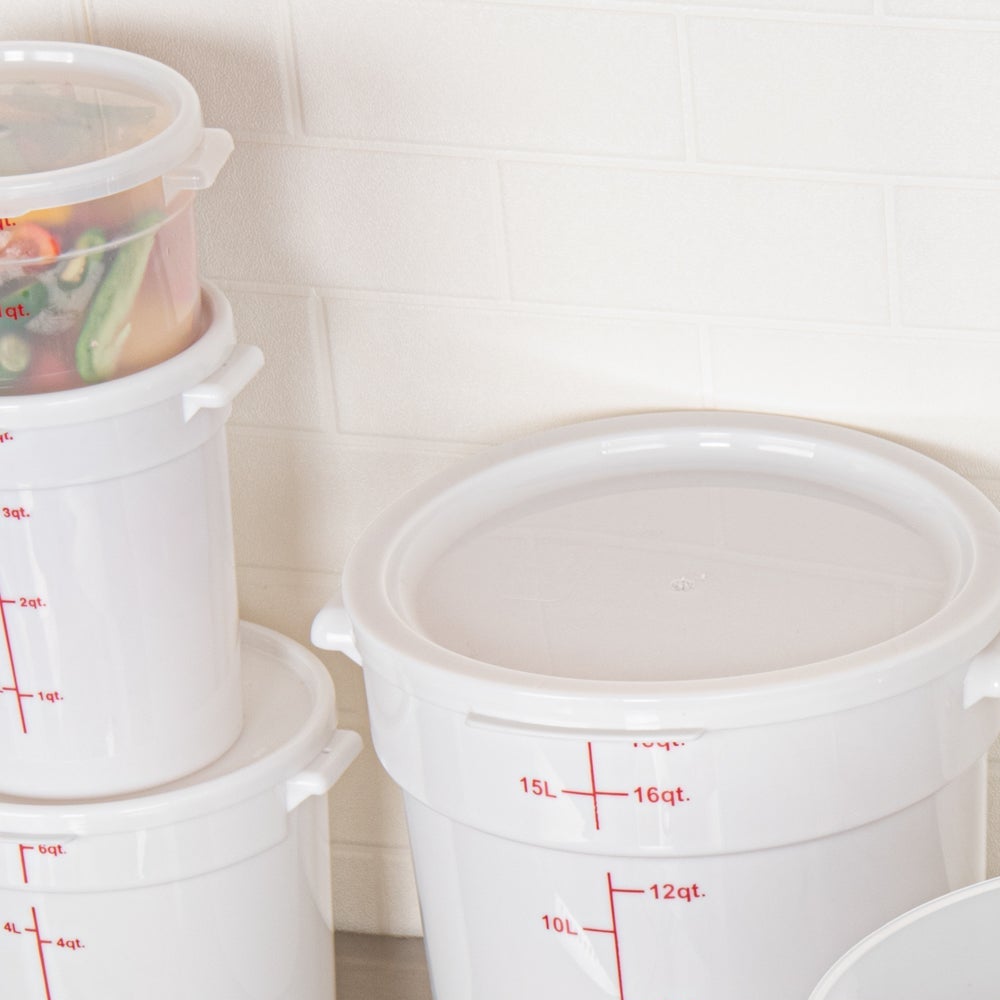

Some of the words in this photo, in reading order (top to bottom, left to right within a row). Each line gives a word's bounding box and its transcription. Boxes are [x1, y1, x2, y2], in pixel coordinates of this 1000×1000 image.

[2, 507, 30, 520] 3qt.
[19, 597, 46, 609] 2qt.
[38, 691, 64, 704] 1qt.
[520, 777, 556, 799] 15L
[634, 786, 690, 806] 16qt.
[650, 883, 706, 902] 12qt.
[3, 922, 21, 934] 4L
[542, 914, 578, 936] 10L
[56, 937, 85, 950] 4qt.
